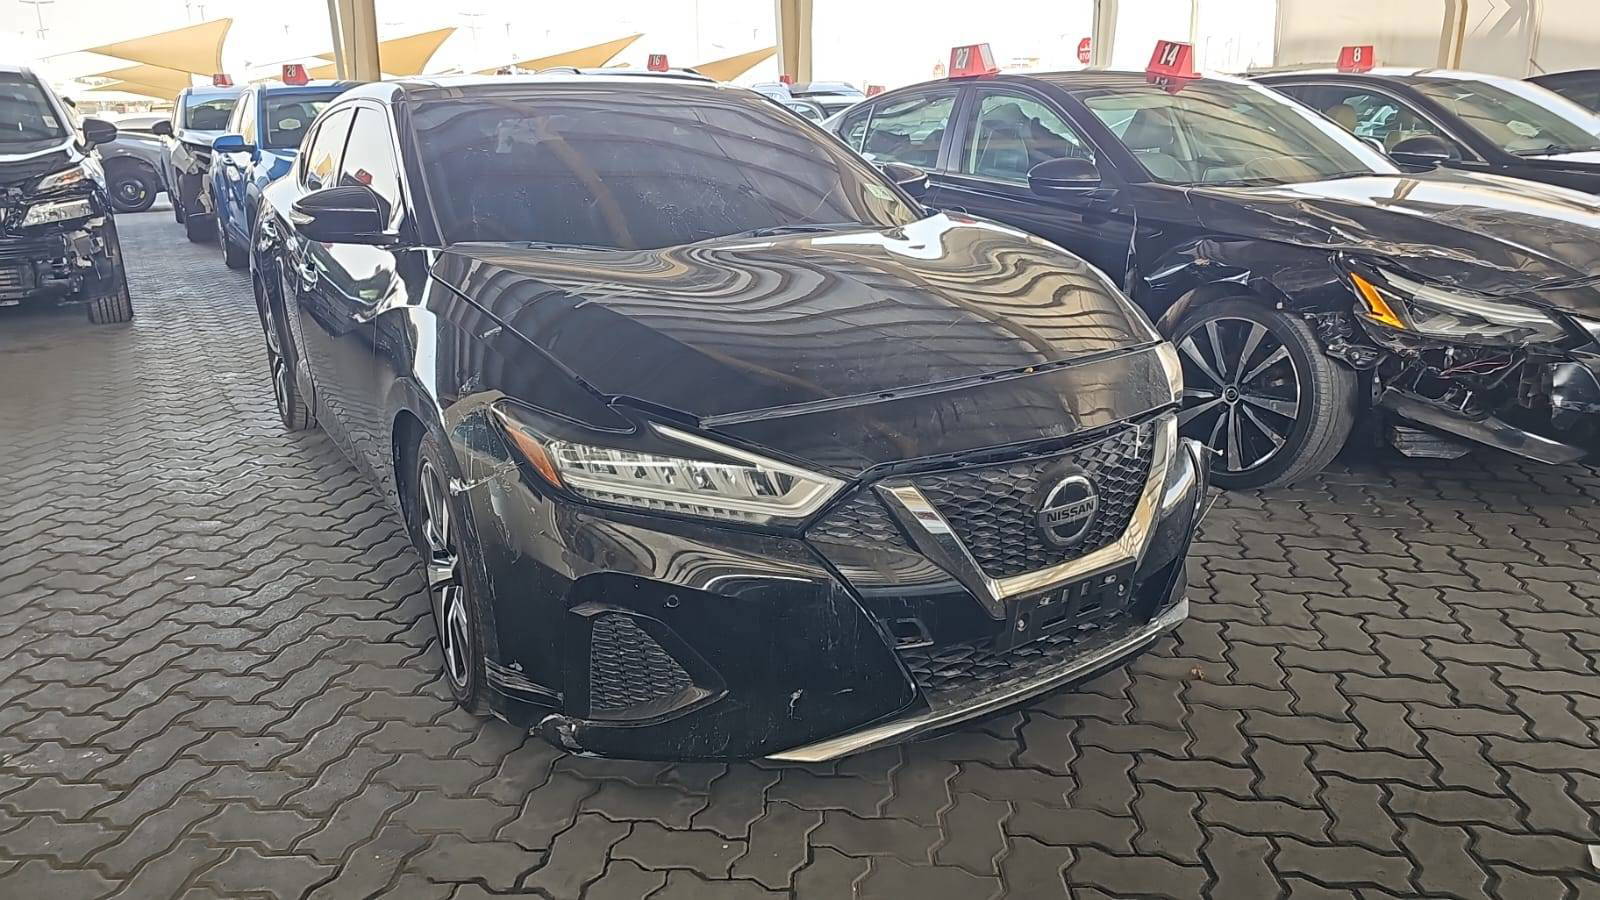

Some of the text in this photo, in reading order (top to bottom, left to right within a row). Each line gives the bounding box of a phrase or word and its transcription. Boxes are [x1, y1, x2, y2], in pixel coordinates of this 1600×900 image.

[955, 48, 970, 69] 27
[1160, 43, 1180, 66] 14
[1353, 47, 1361, 62] 8
[287, 65, 297, 77] 28
[1047, 501, 1094, 522] NISSAN
